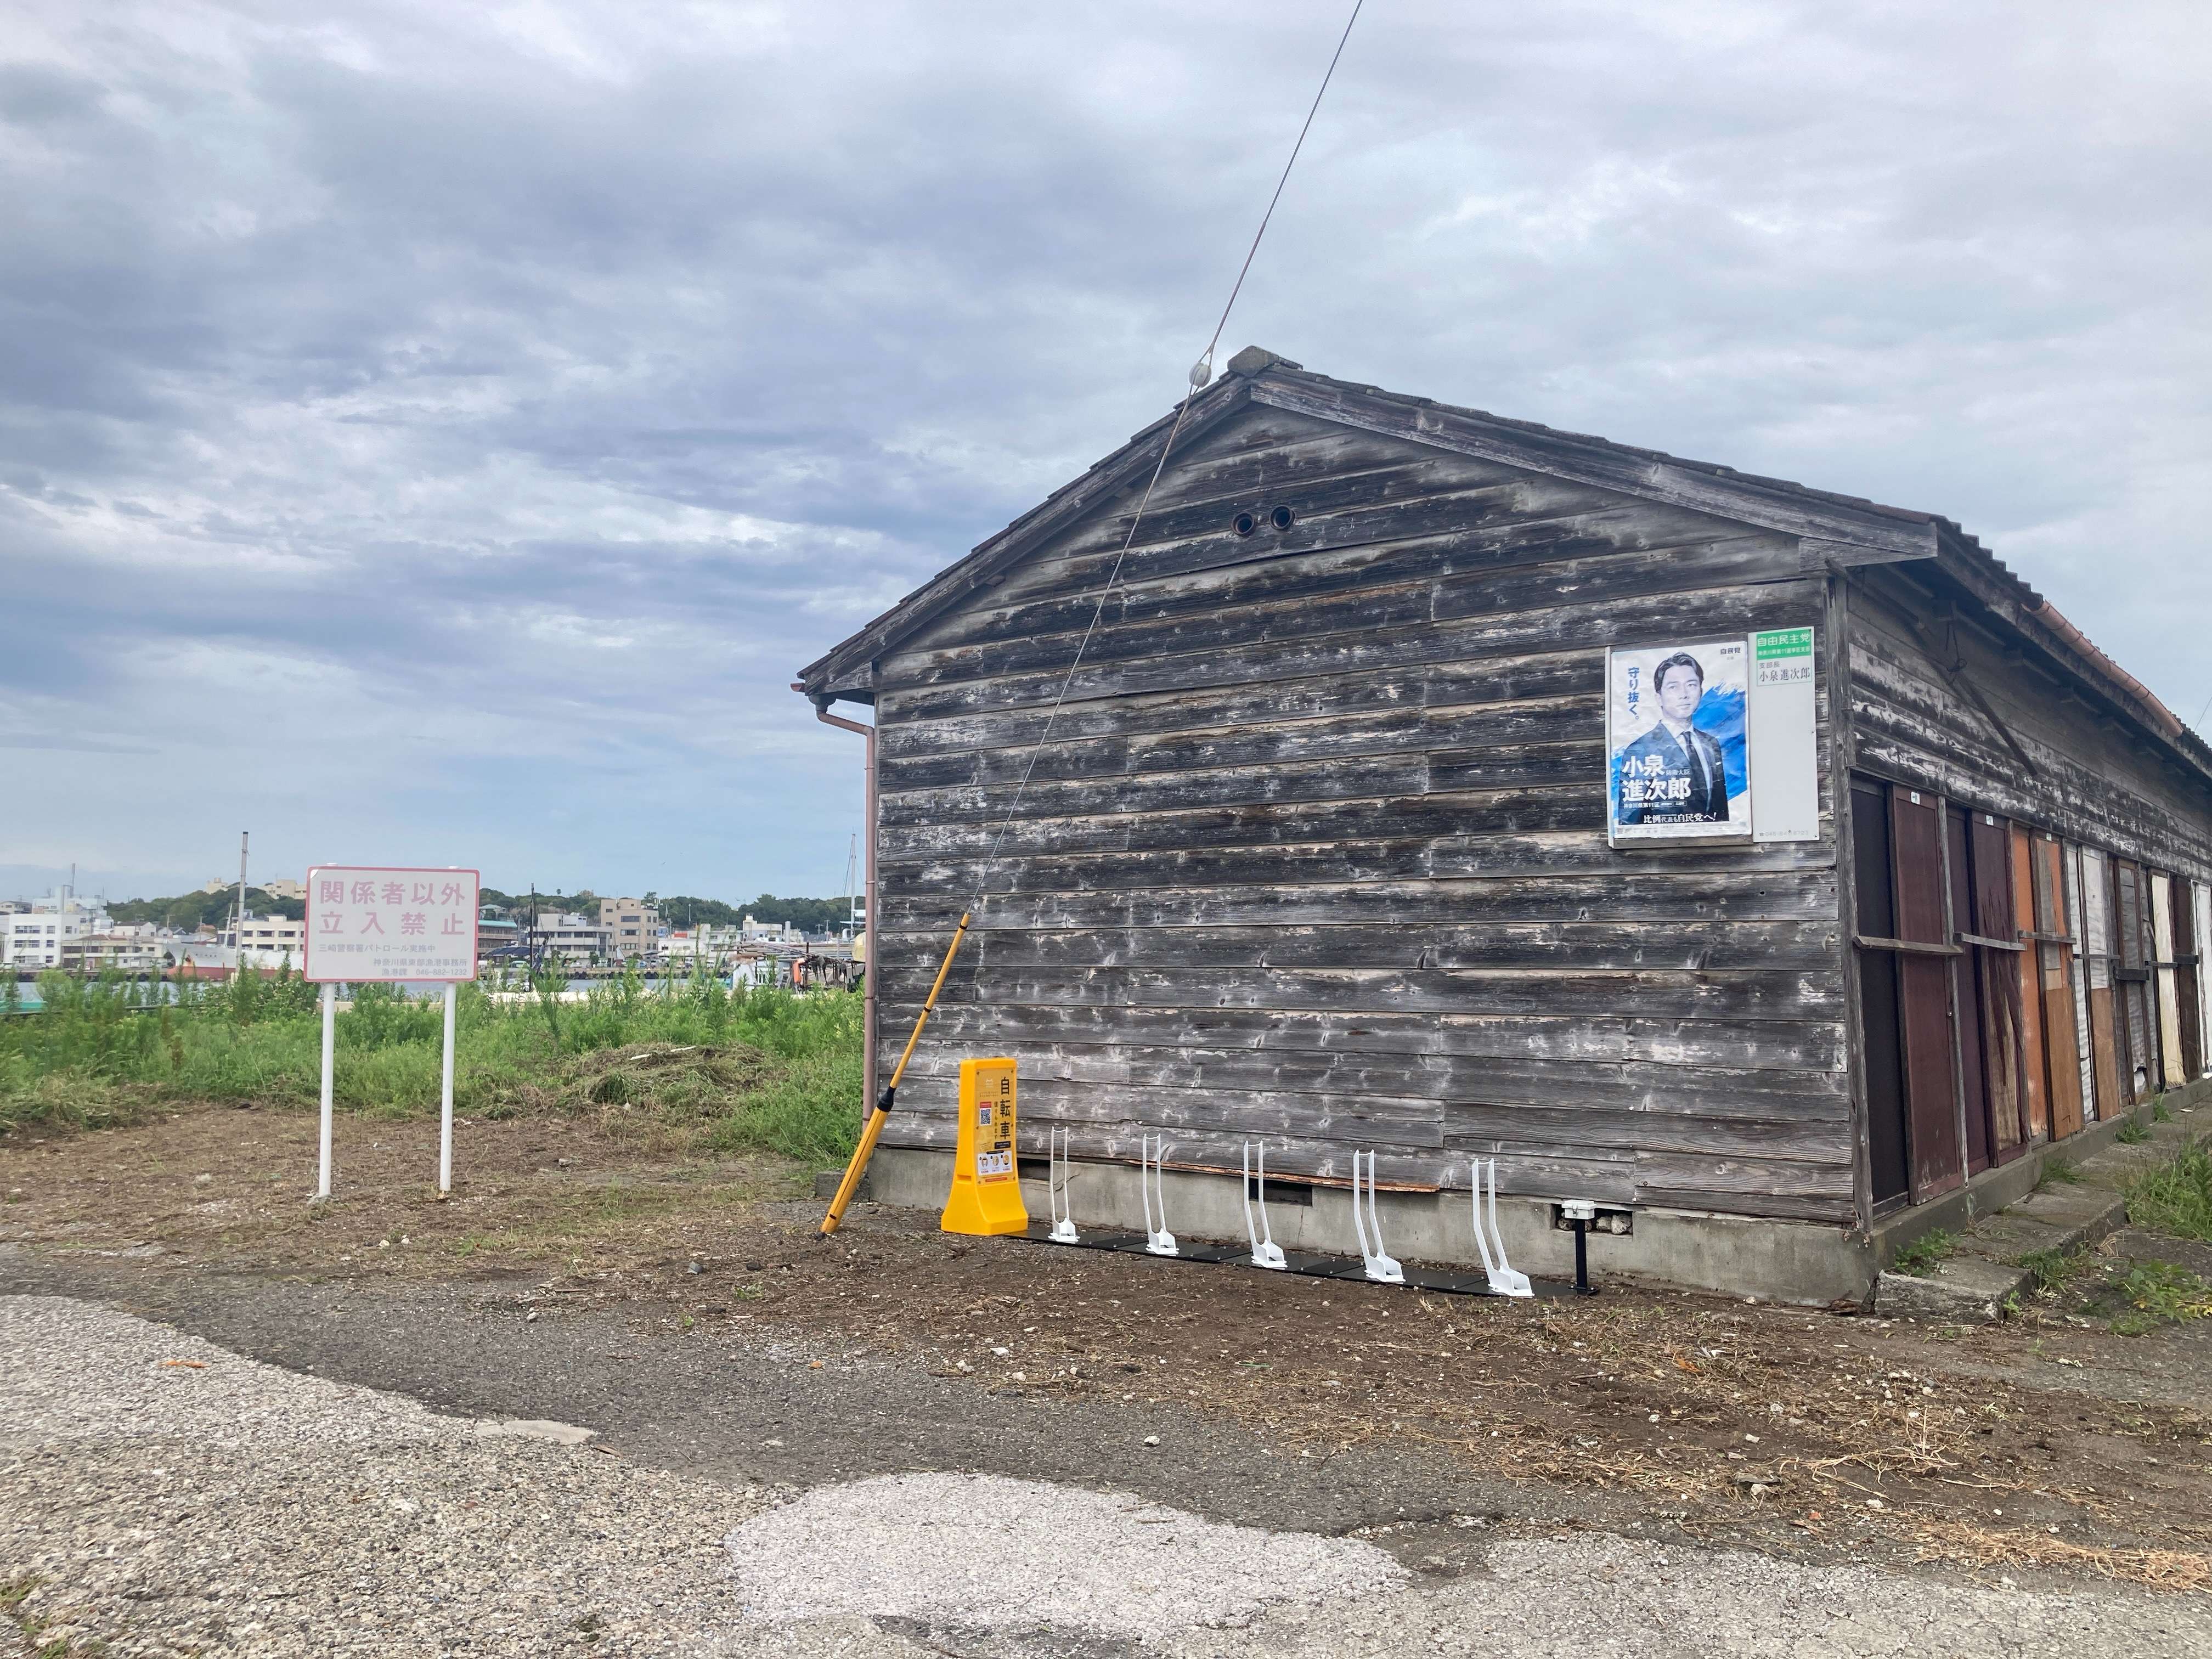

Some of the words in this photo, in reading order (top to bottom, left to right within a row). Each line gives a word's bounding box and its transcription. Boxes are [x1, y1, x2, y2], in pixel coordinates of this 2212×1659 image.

[1757, 633, 1810, 647] 自由民主党
[1759, 667, 1810, 681] 小泉進次郎
[1627, 667, 1639, 720] 守り抜く。
[1621, 754, 1665, 778] 小泉
[1622, 777, 1691, 802] 進次郎
[320, 881, 465, 906] 関係者以外
[319, 911, 465, 935] 立入禁止
[319, 944, 436, 953] 三崎警察署パトロール実施中
[374, 958, 467, 967] 神奈川県東部漁港事務所
[1000, 1076, 1011, 1139] 自転車
